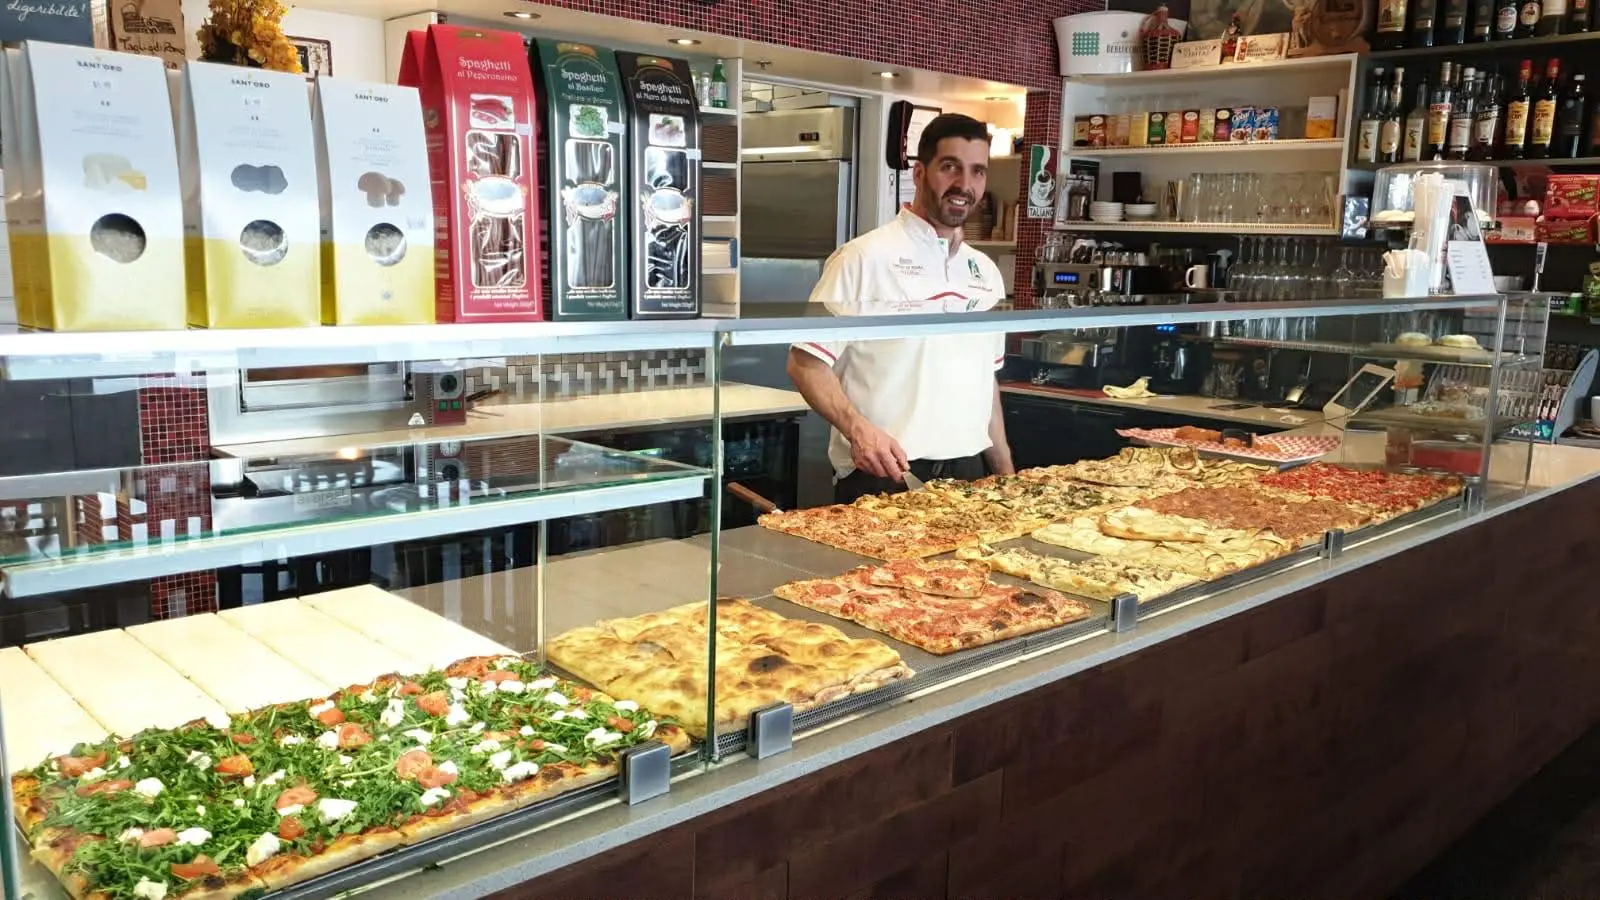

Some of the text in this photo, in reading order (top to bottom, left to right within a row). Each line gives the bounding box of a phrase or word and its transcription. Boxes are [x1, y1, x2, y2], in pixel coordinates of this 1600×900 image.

[77, 60, 123, 72] SANT'ORO
[458, 56, 511, 71] Spaghetti
[467, 70, 518, 81] Peperoncino
[560, 68, 607, 84] Spaghetti
[231, 79, 271, 89] SANT'ORO
[576, 83, 605, 93] Basilico
[640, 80, 682, 95] Spaghetti
[355, 93, 389, 103] SANT'ORO
